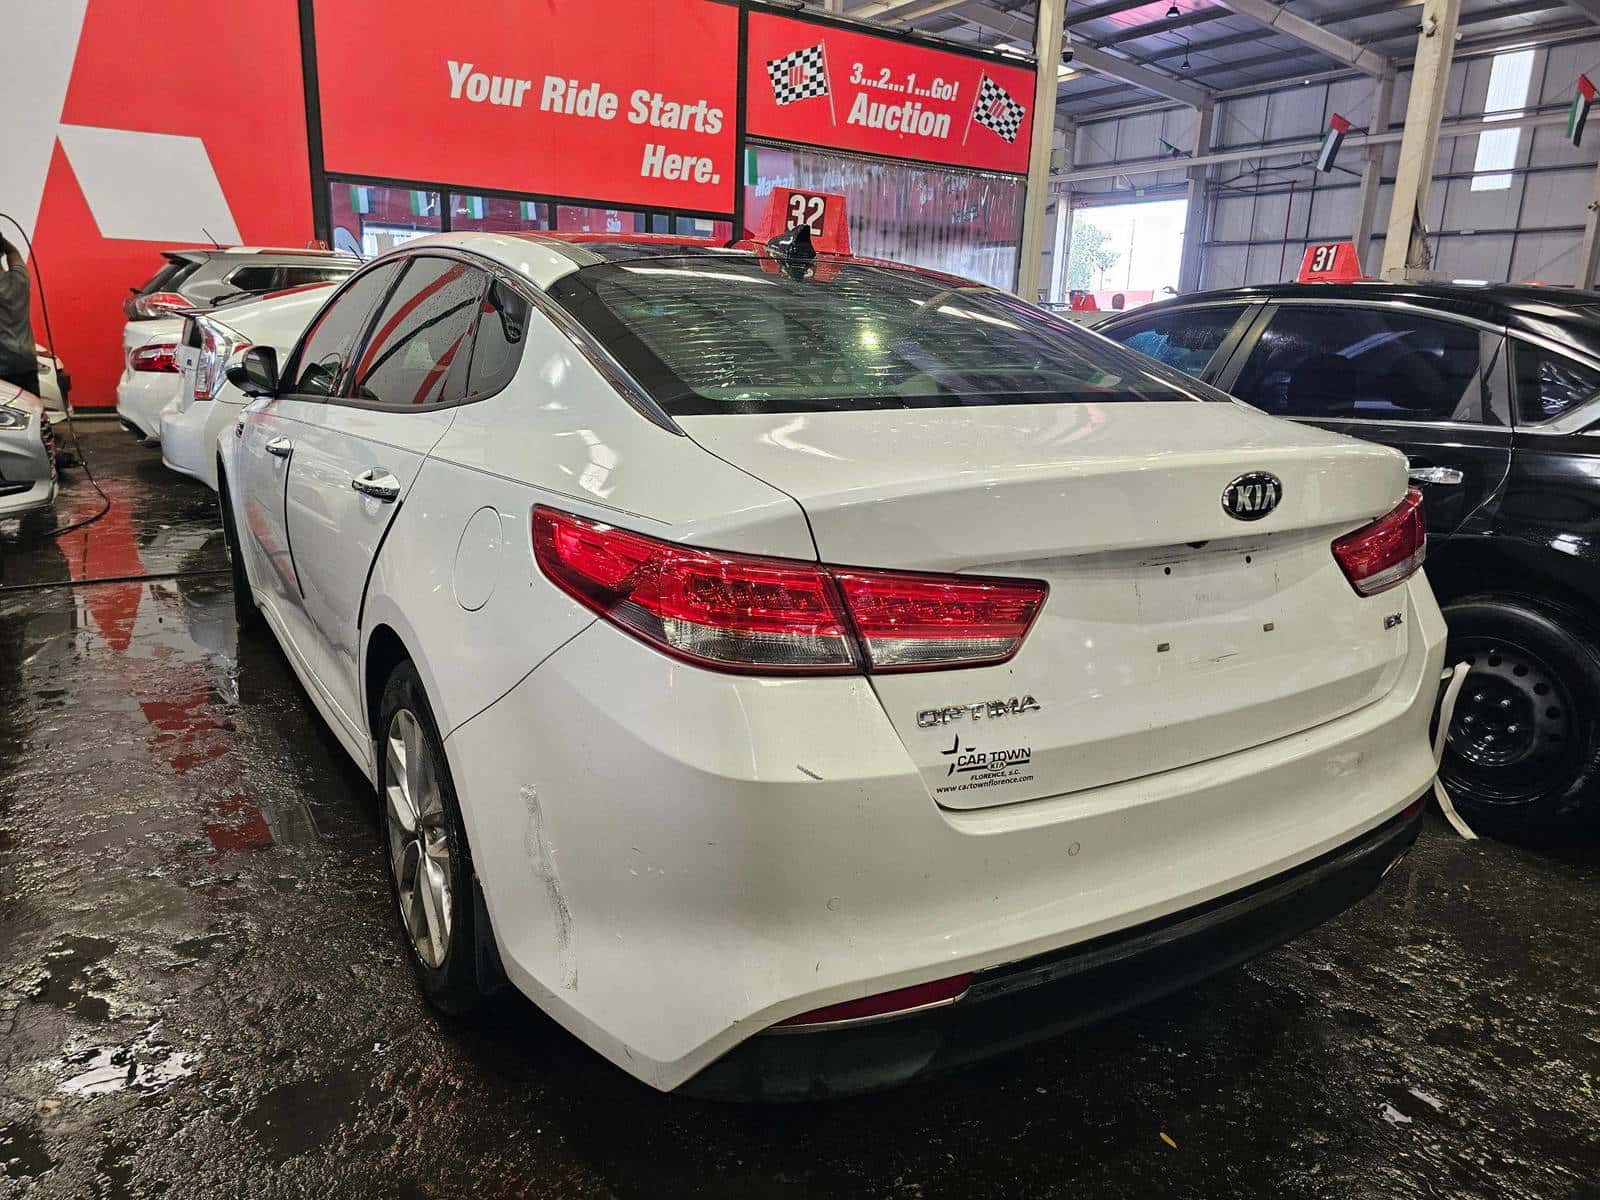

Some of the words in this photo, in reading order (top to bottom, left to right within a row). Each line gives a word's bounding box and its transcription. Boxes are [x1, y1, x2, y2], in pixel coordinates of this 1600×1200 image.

[448, 61, 532, 107] Your
[540, 75, 619, 121] Ride
[627, 89, 724, 135] Starts
[847, 92, 952, 139] Auction
[640, 143, 721, 185] Here.
[787, 194, 825, 236] 32
[1312, 245, 1338, 272] 31
[1235, 483, 1276, 512] KIA
[1383, 612, 1402, 630] EX
[916, 694, 1041, 727] OPTIMA
[957, 753, 987, 767] CAR
[989, 747, 1031, 762] TOWN
